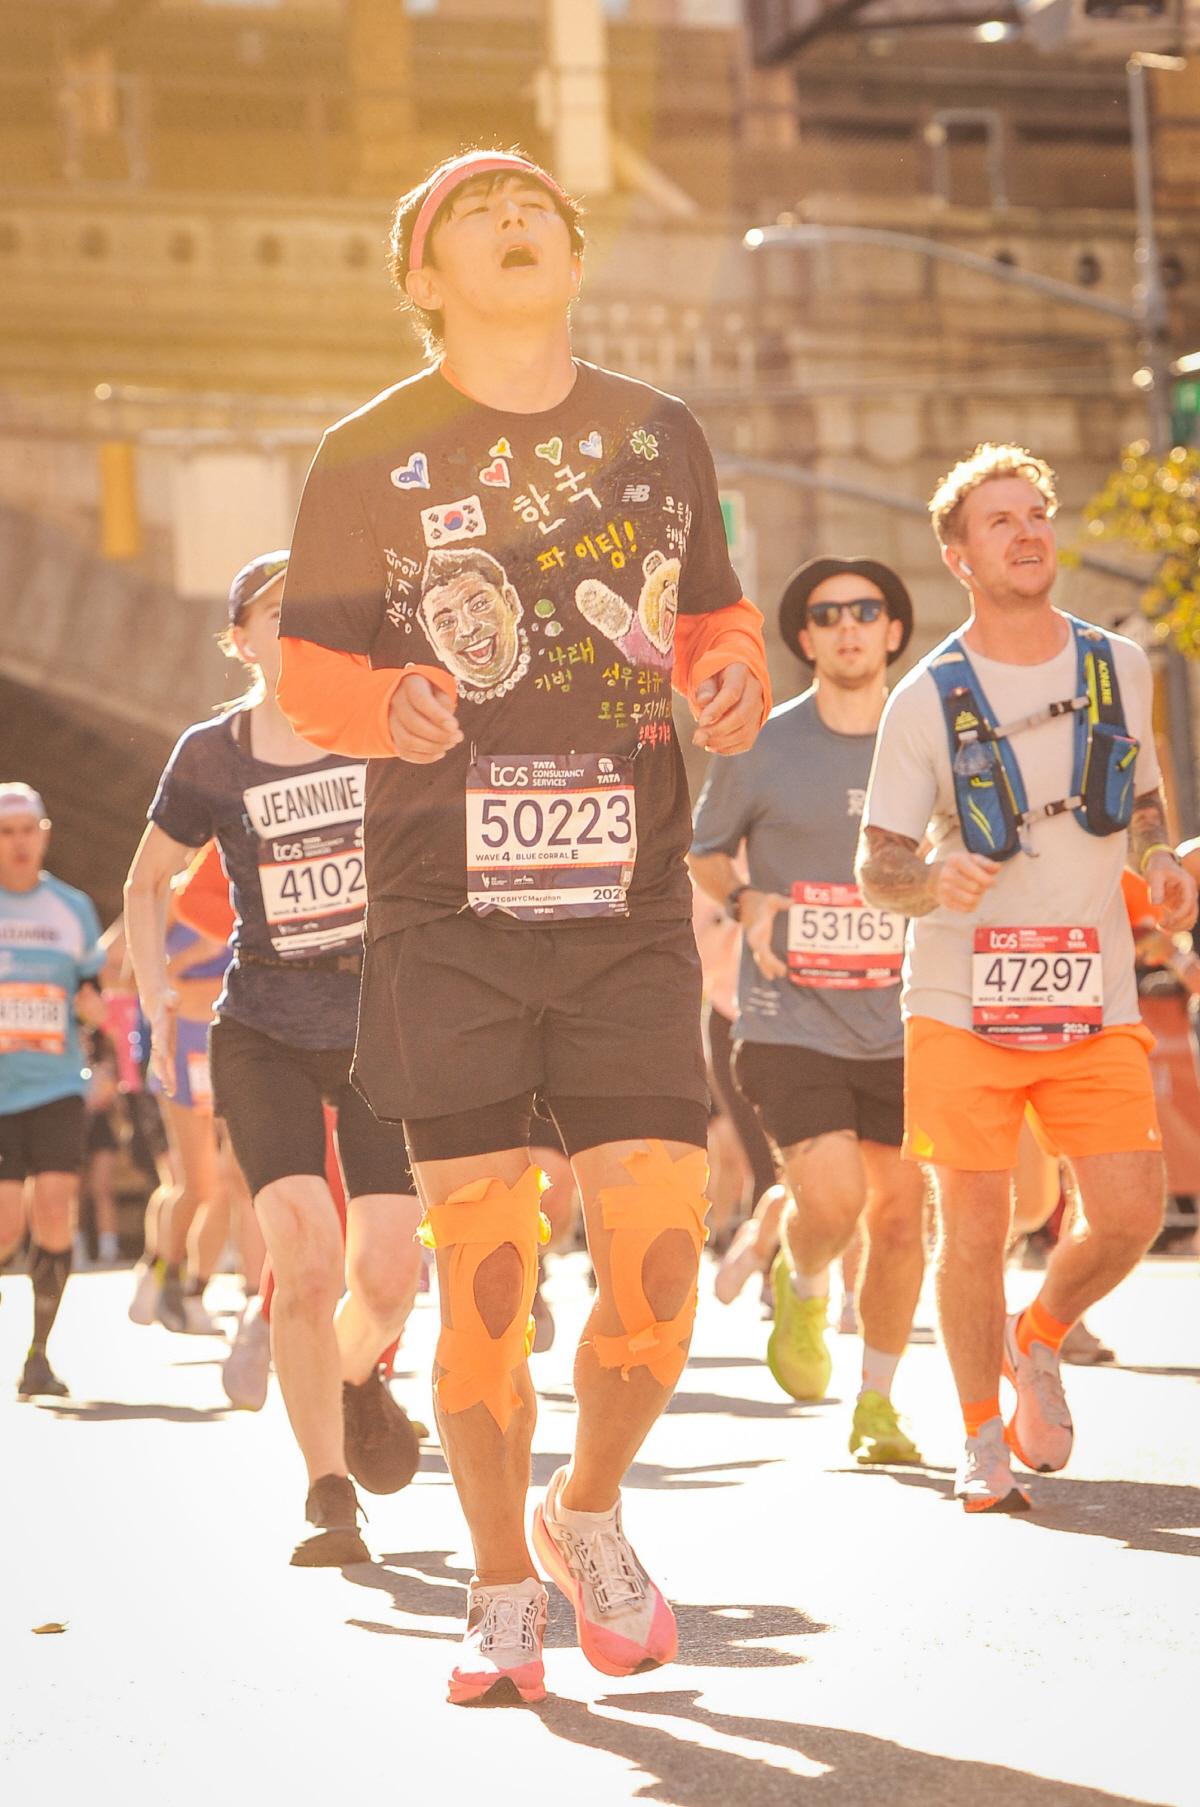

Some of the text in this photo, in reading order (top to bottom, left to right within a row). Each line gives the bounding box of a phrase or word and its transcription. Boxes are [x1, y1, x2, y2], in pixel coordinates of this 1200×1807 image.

[512, 464, 602, 535] 한국
[548, 636, 594, 665] 나래
[534, 669, 573, 693] 기범
[598, 701, 628, 728] 모든
[490, 761, 529, 788] tcs
[532, 761, 556, 769] TATA
[532, 769, 585, 778] CONSULTANCY
[597, 773, 621, 784] TATA
[532, 778, 567, 787] SERVICES
[260, 776, 363, 828] JEANNINE
[481, 794, 632, 848] 50223
[476, 849, 579, 862] WAVE 4 BLUE CORRAL E
[802, 910, 894, 941] 53165
[989, 930, 1018, 949] tcs
[984, 958, 1093, 992] 47297
